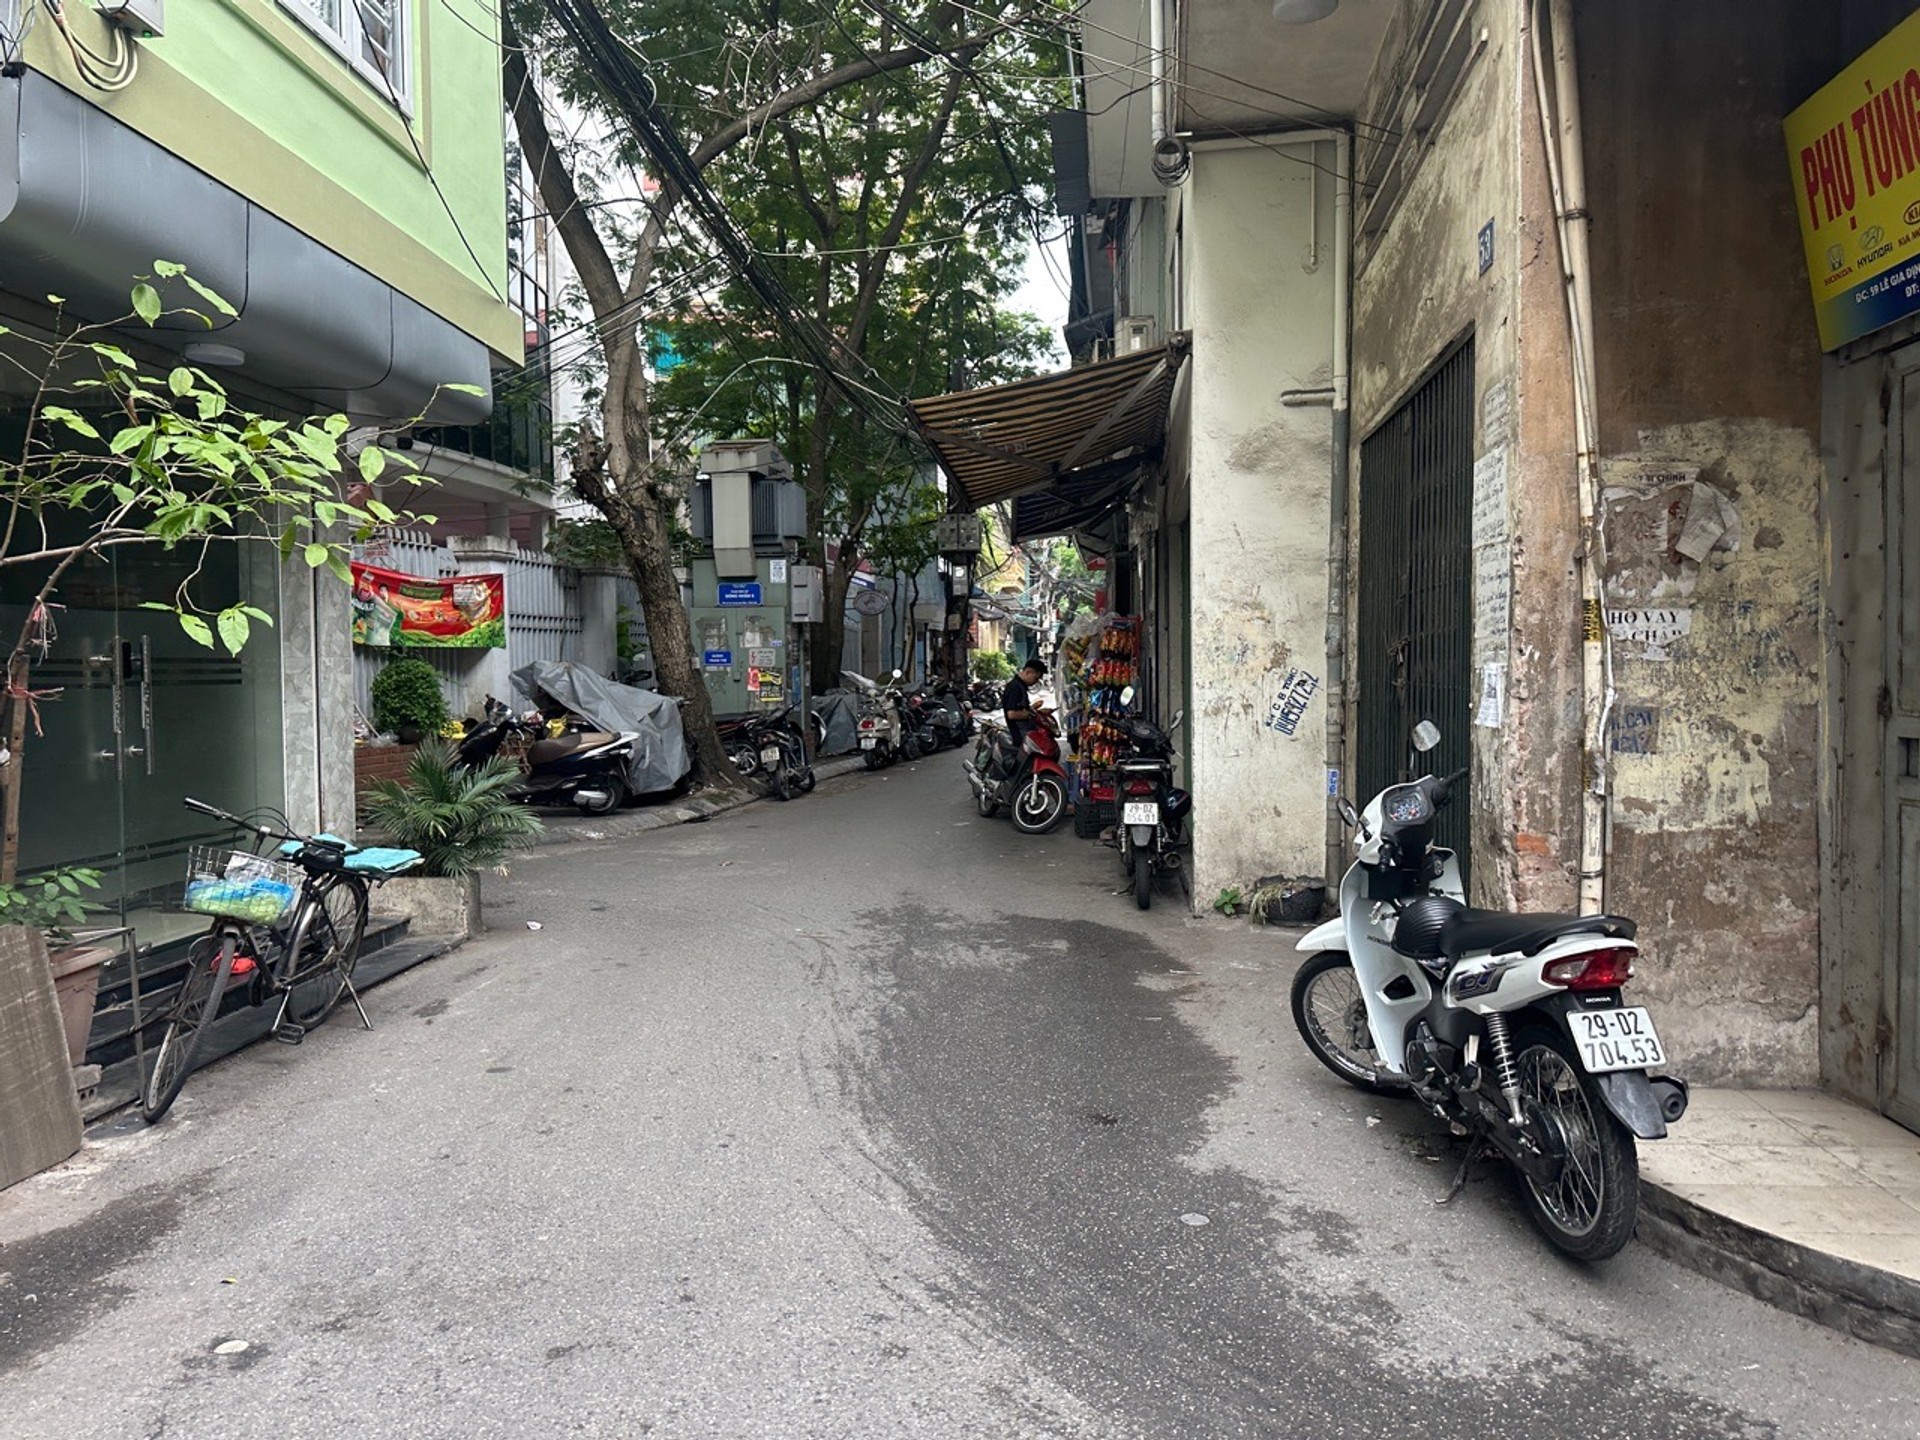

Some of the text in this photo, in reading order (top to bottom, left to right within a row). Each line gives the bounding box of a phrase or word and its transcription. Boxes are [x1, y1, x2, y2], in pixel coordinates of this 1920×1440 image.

[1801, 121, 1857, 231] PHỤ
[1857, 242, 1893, 269] HYUNDAI
[1824, 266, 1854, 286] HONDA
[1869, 284, 1880, 297] 59
[1890, 271, 1906, 287] GIA
[1643, 610, 1679, 624] VAY
[1582, 1011, 1644, 1039] 29-D2
[1584, 1038, 1661, 1068] 704.53
